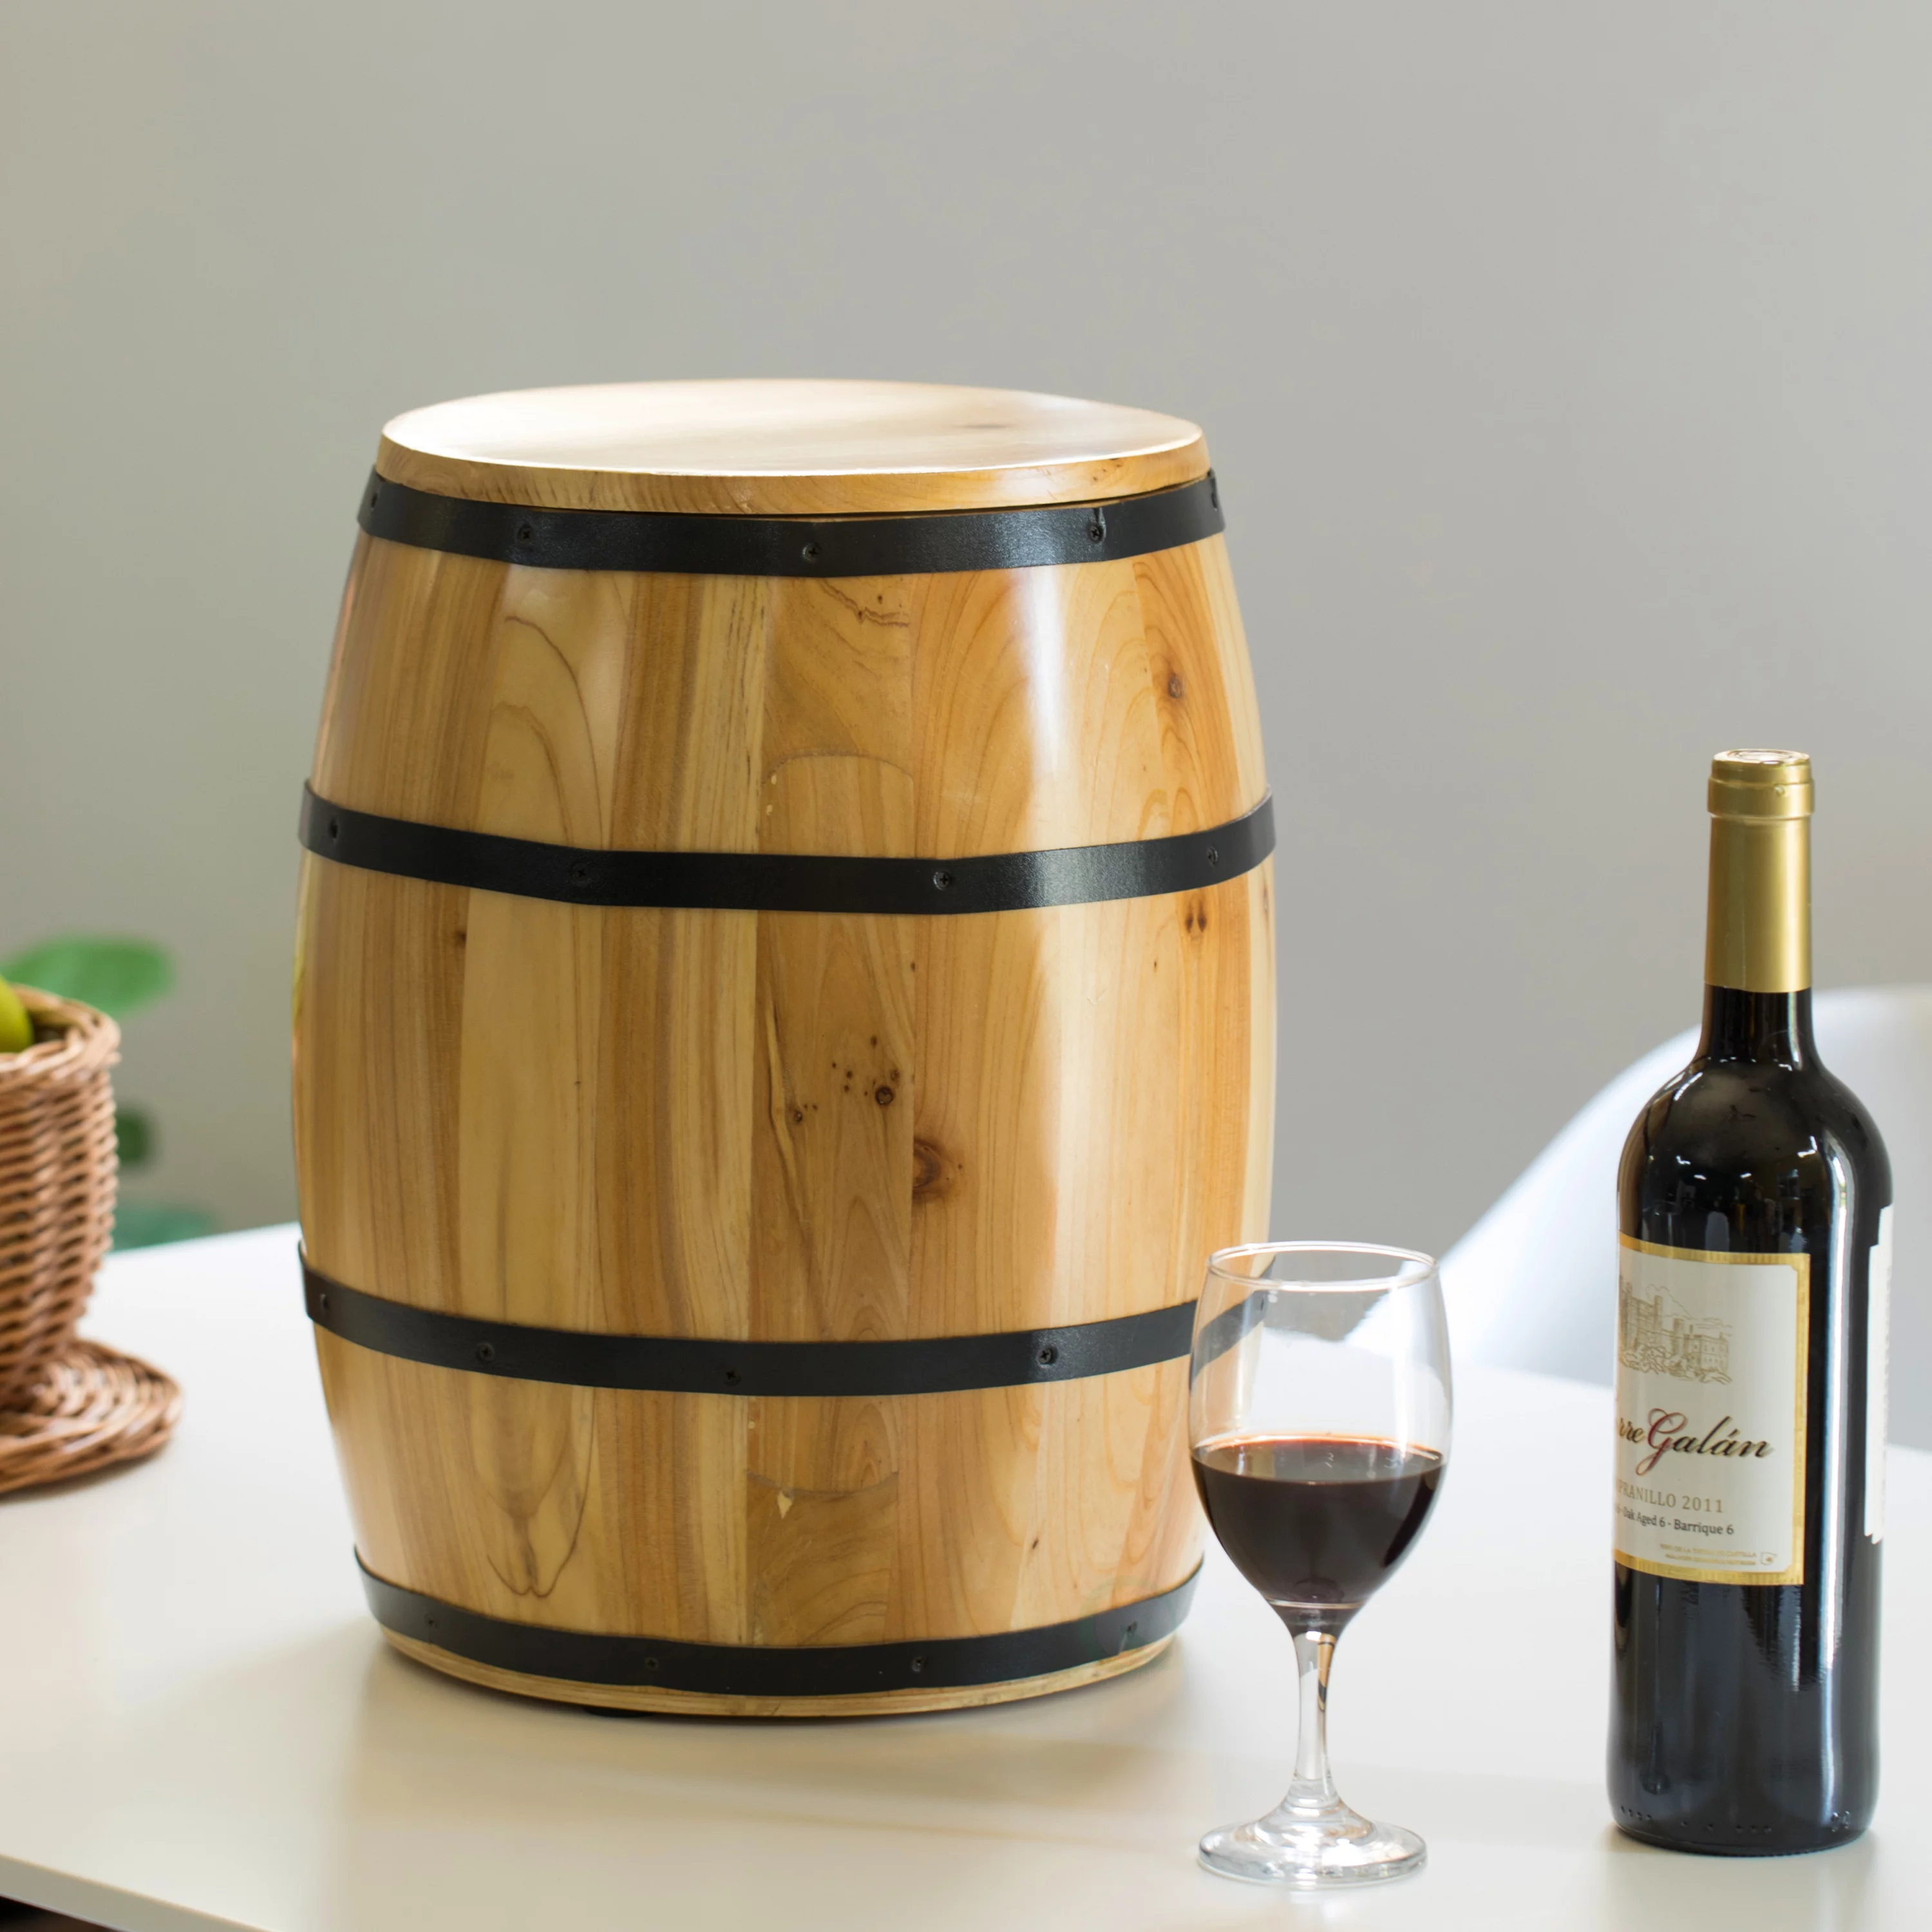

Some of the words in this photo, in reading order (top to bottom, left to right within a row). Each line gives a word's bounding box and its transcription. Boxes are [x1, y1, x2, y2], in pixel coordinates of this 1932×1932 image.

[1618, 1417, 1645, 1444] rre
[1636, 1408, 1772, 1475] Galán
[1617, 1479, 1676, 1508] PRANILLO
[1681, 1495, 1723, 1513] 2011
[1636, 1511, 1658, 1527] Aged
[1659, 1517, 1666, 1528] 6
[1673, 1519, 1724, 1537] Barrique
[1726, 1524, 1734, 1535] 6
